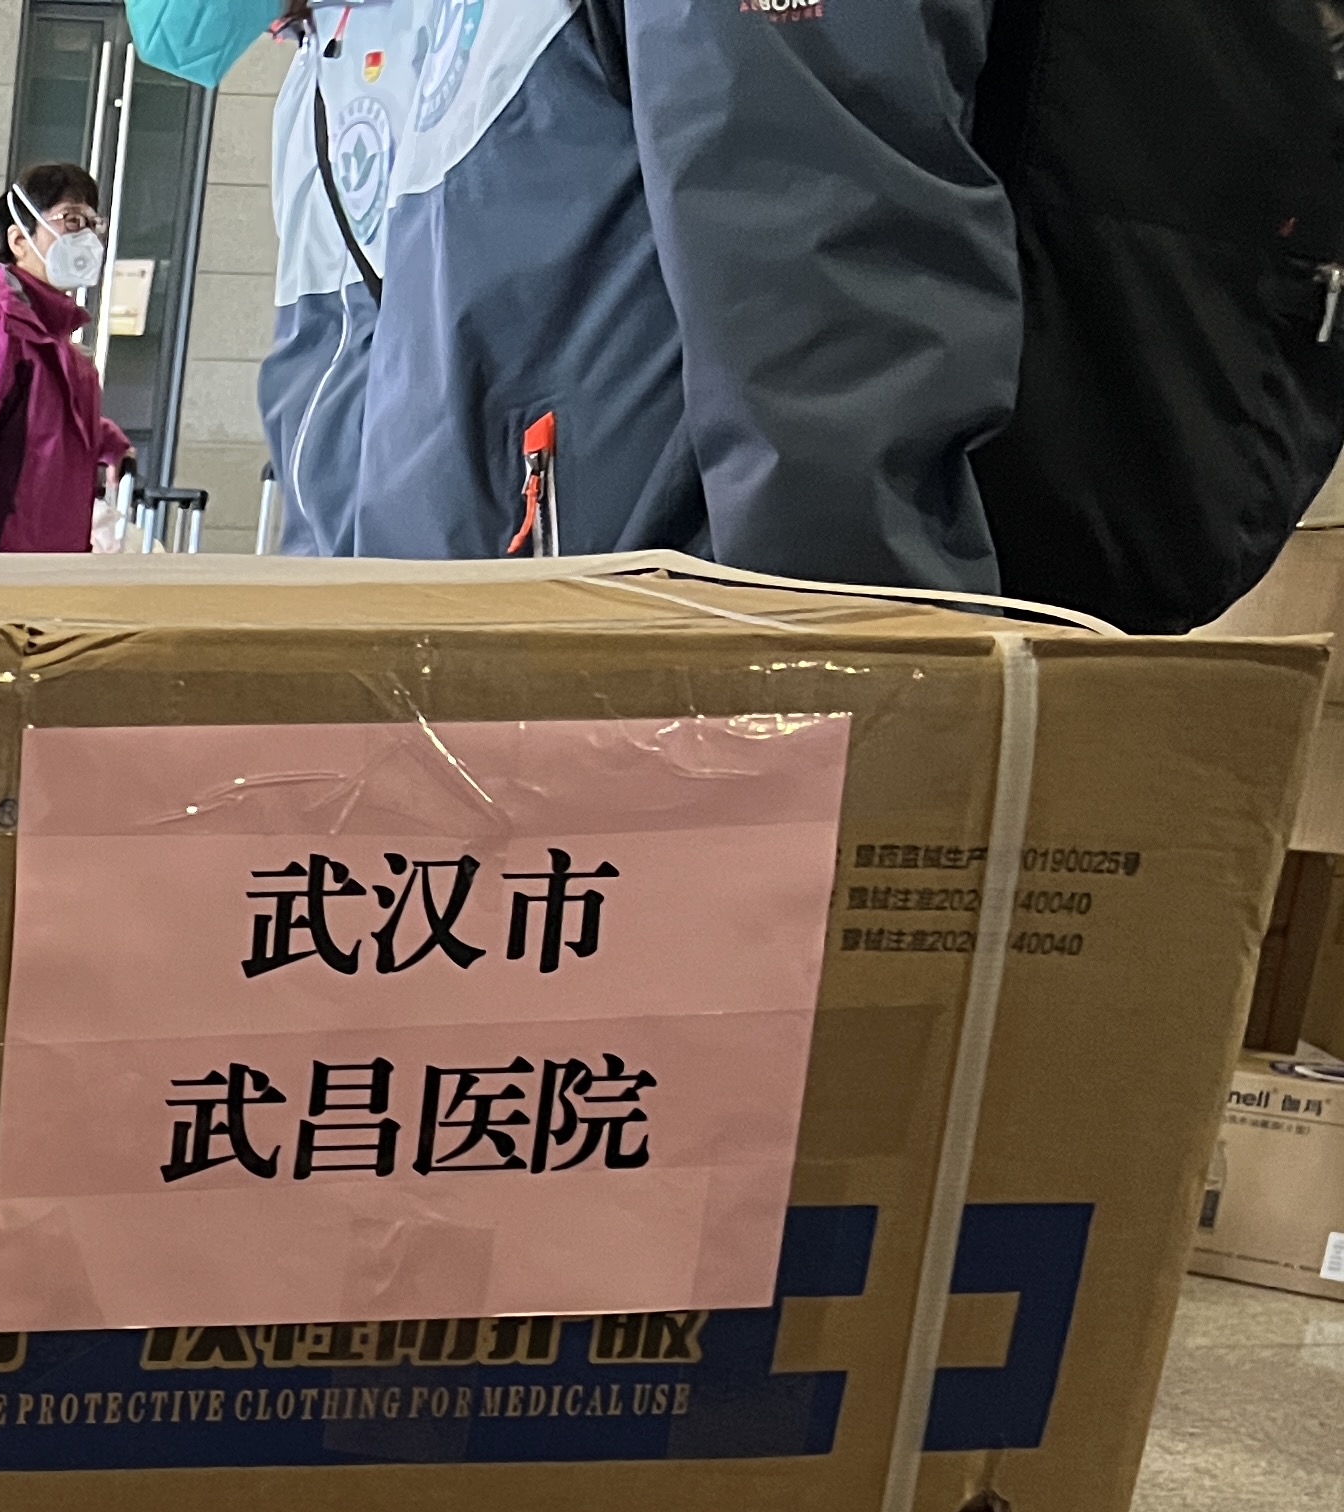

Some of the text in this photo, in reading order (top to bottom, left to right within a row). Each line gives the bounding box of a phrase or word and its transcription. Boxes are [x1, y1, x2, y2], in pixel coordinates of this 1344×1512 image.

[241, 848, 620, 979] 武汉市
[160, 1053, 657, 1183] 武昌医院
[16, 1388, 223, 1425] PROTECTIVE
[234, 1386, 401, 1422] CLOTHING
[409, 1385, 473, 1420] FOR
[482, 1383, 624, 1418] MEDICAL
[633, 1382, 691, 1416] USE
